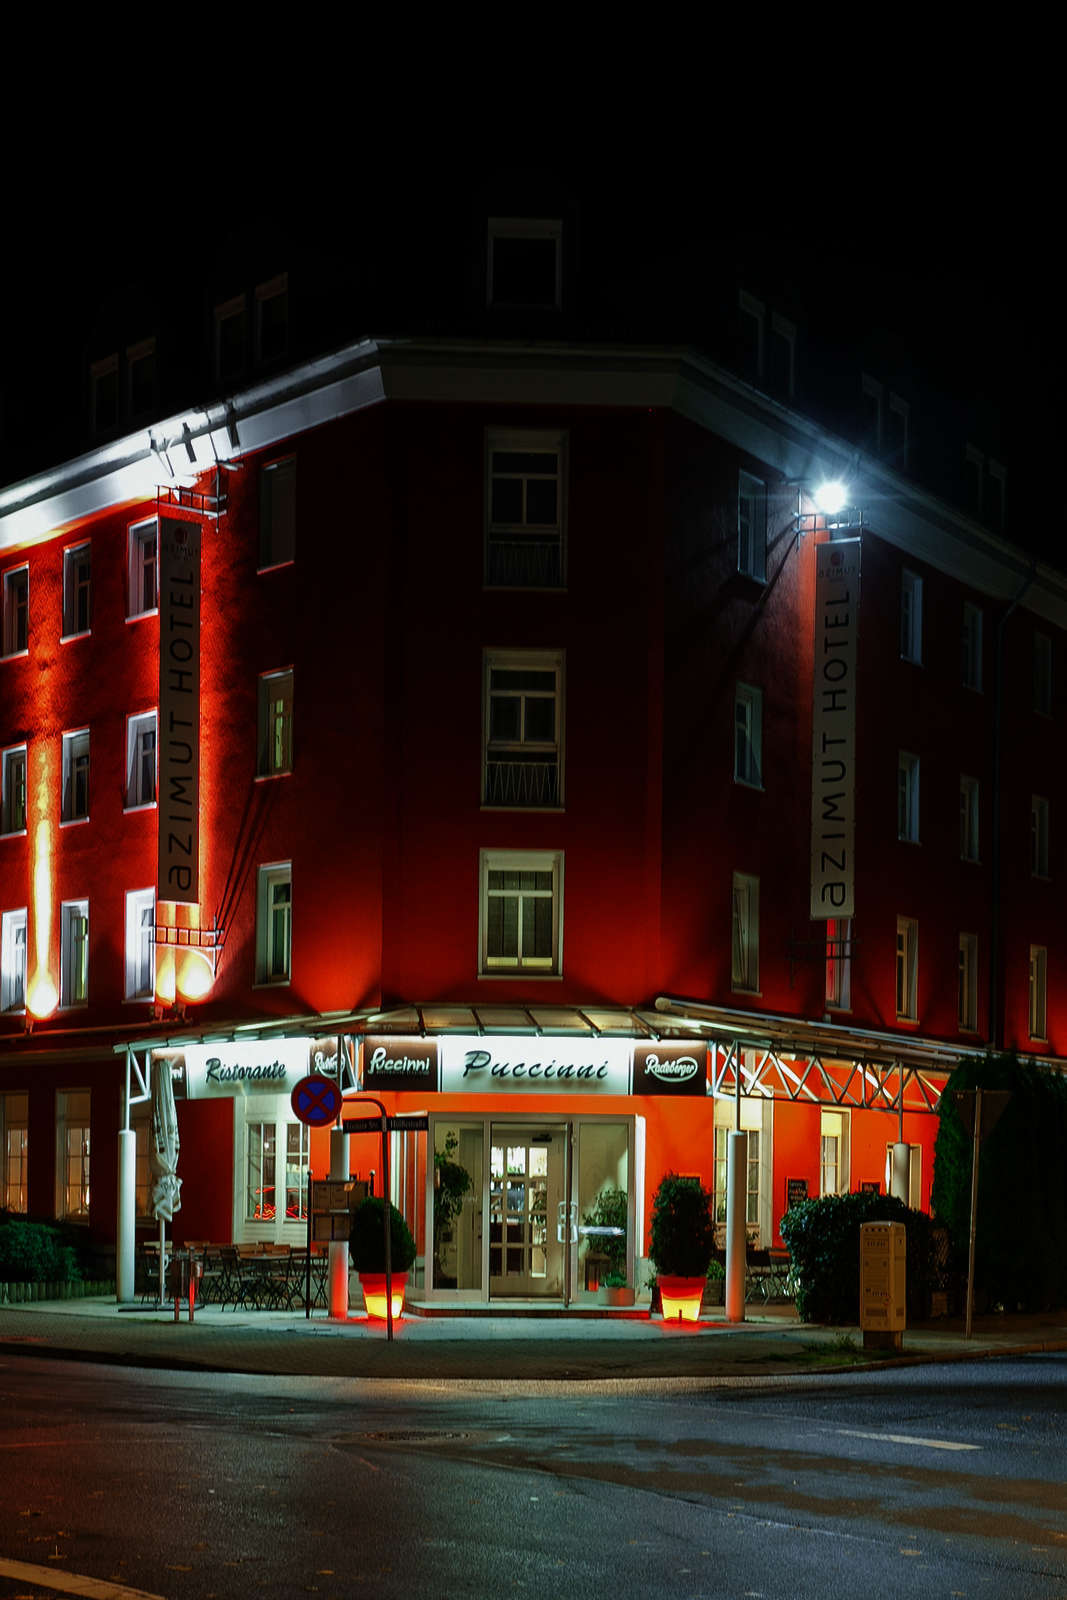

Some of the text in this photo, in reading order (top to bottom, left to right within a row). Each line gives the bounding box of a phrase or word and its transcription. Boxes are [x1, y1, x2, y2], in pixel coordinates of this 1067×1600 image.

[169, 571, 194, 693] HOTEL
[822, 590, 849, 712] HOTEL
[205, 1057, 287, 1083] Ristorante
[368, 1047, 430, 1074] Puccinni
[463, 1050, 608, 1079] Puccinni
